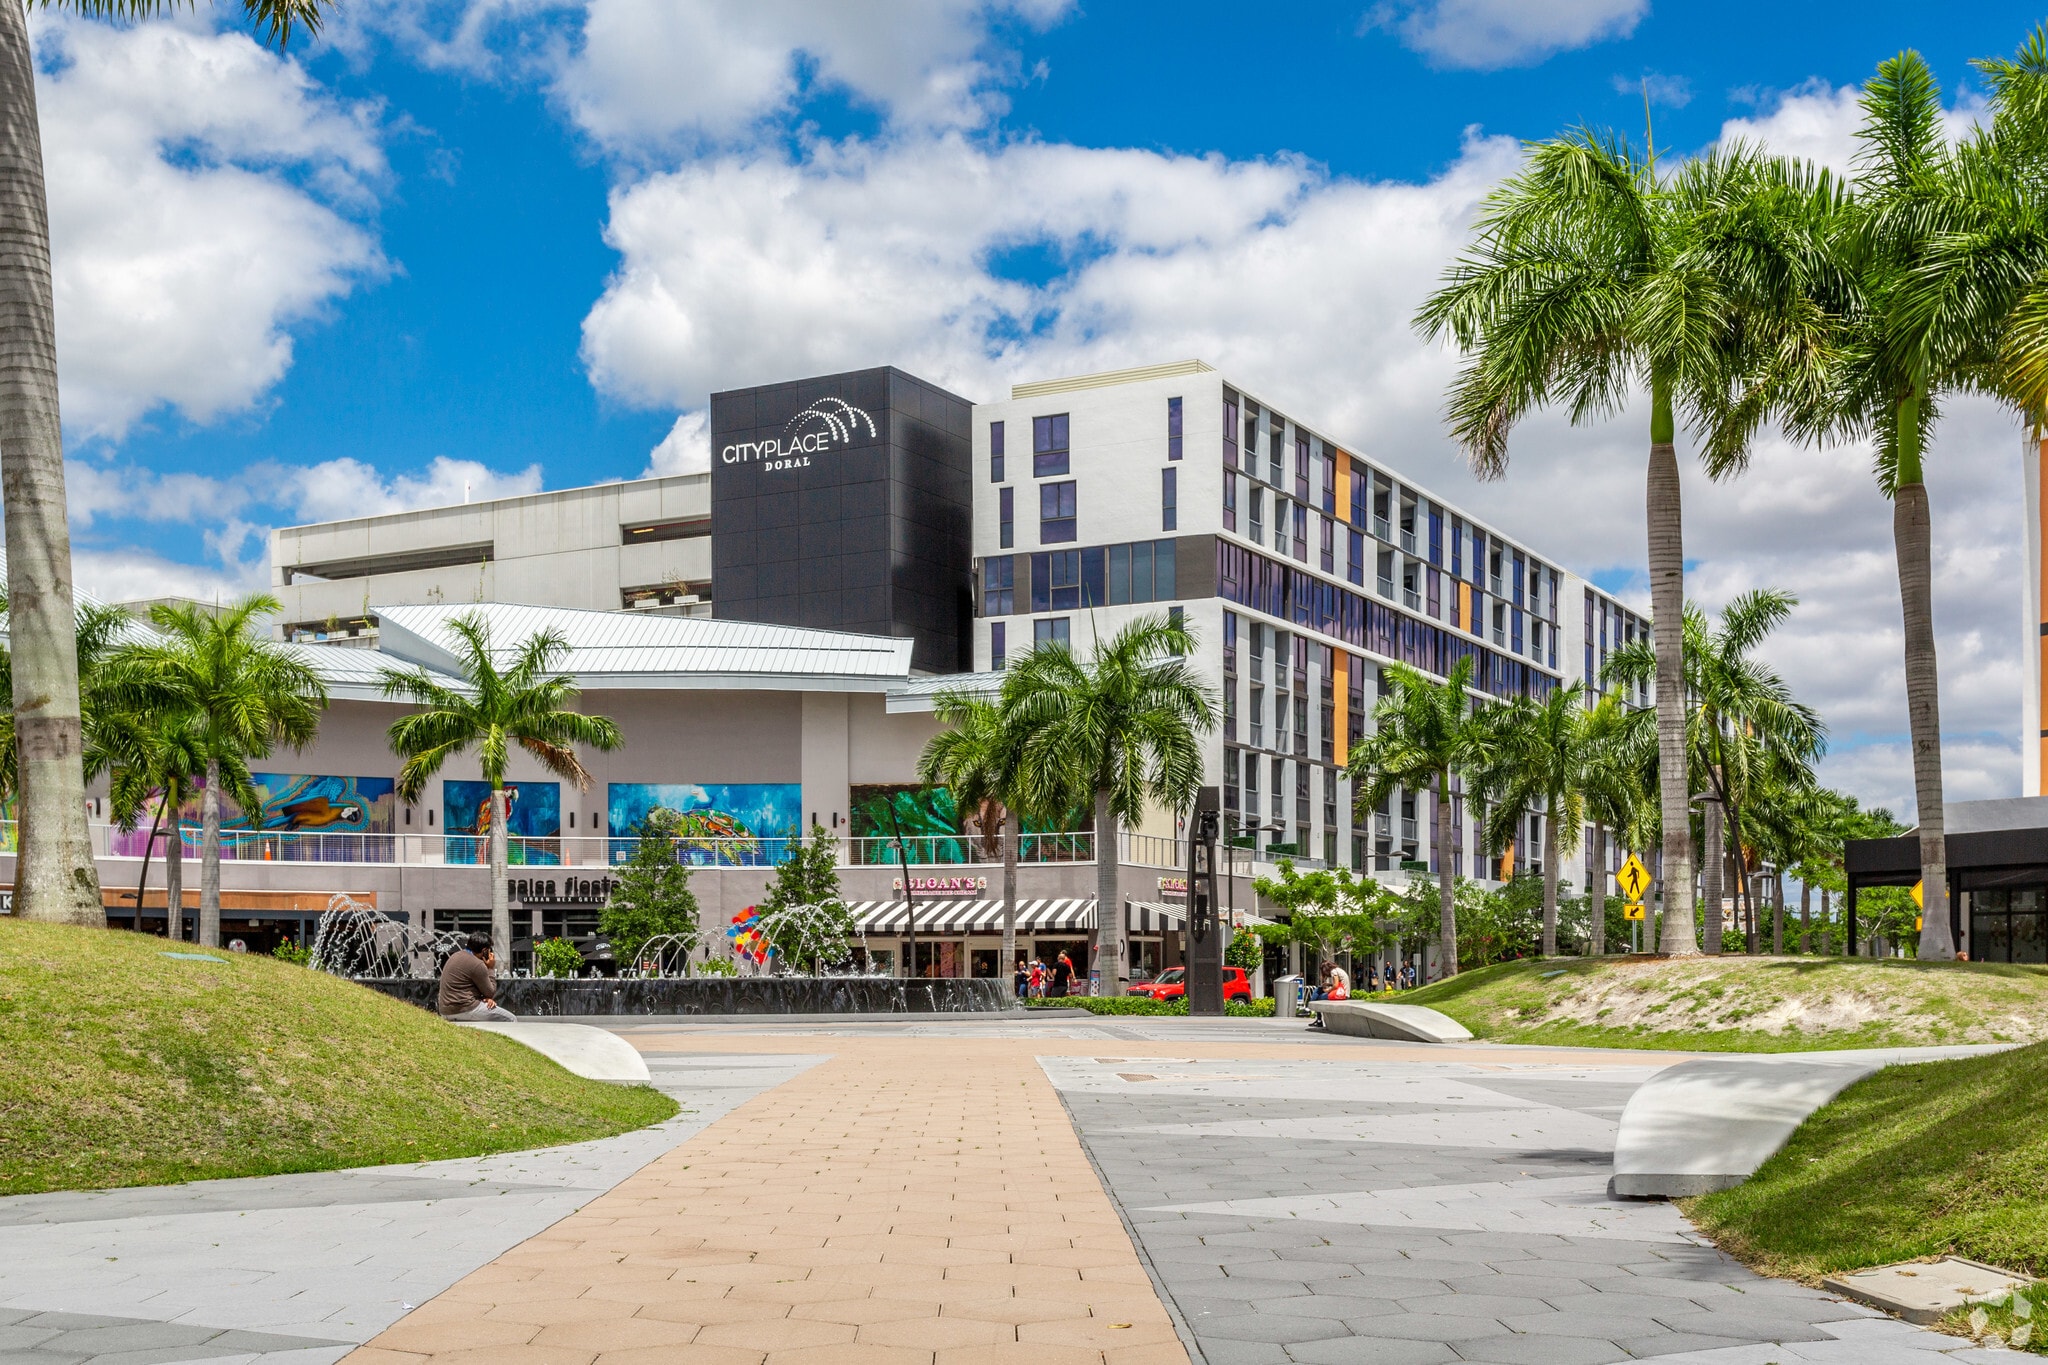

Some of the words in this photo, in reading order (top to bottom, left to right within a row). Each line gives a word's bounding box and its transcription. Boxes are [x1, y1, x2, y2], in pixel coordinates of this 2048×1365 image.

[722, 431, 829, 464] CITYPLACE
[764, 457, 811, 472] DORAL
[508, 878, 556, 898] salsa
[523, 896, 550, 904] URBAN
[556, 896, 572, 904] MEX
[578, 896, 605, 904] GRILL
